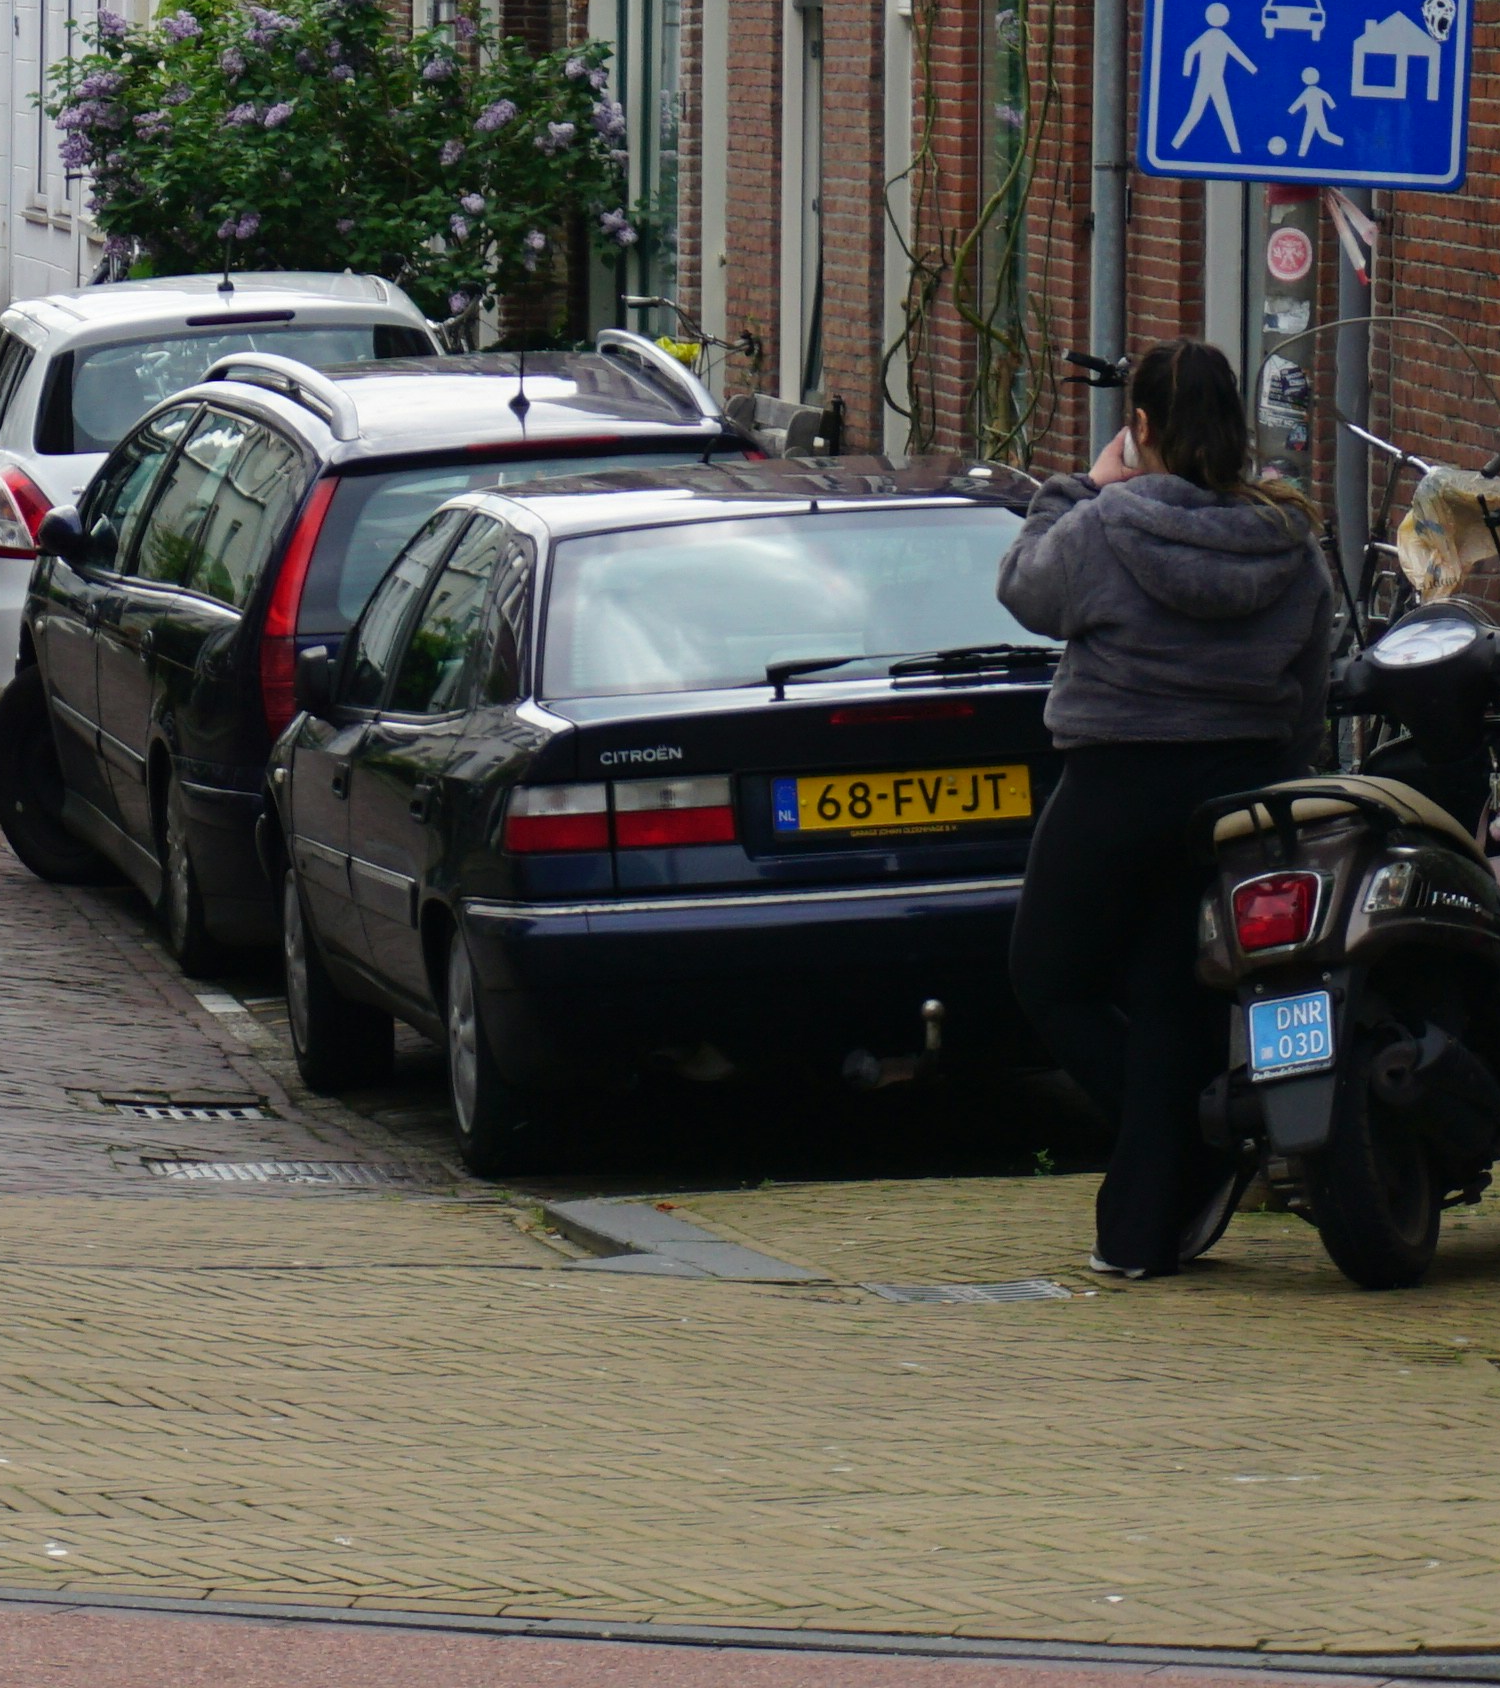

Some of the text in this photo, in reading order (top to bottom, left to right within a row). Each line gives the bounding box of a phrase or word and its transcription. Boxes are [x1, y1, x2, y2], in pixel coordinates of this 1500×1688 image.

[600, 744, 683, 765] CITROËN
[817, 773, 1006, 820] 68-FV-JT
[778, 809, 796, 822] NL
[1277, 1001, 1323, 1030] DNR
[1279, 1030, 1324, 1059] 03D
